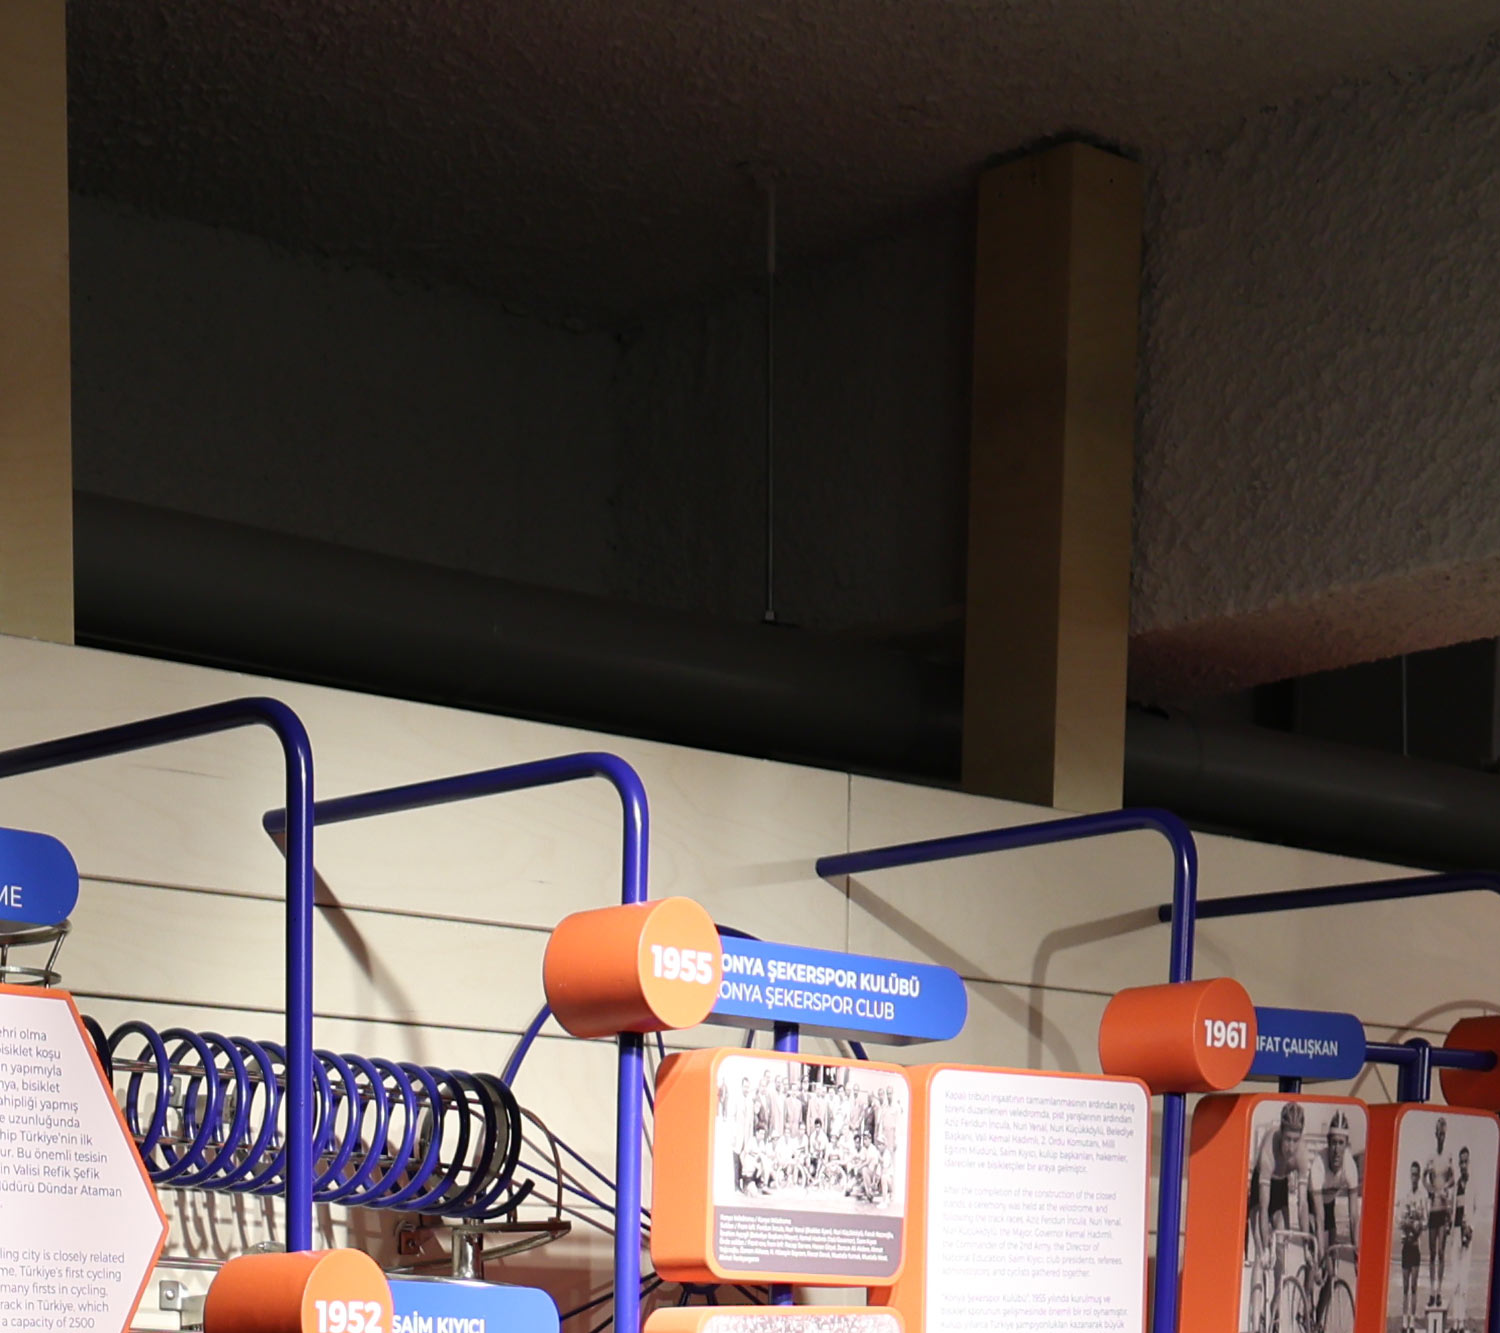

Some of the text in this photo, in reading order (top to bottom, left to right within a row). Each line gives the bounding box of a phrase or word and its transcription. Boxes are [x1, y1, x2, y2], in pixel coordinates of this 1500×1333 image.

[651, 944, 713, 984] 1955
[721, 953, 920, 998] ONYA ŞEKERSPOR KULÜBÜ
[717, 980, 895, 1020] ONYA ŞEKERSPOR CLUB
[18, 1026, 49, 1043] olma
[1204, 1019, 1247, 1049] 1961
[1256, 1035, 1338, 1059] IFAT ÇALIŞKAN
